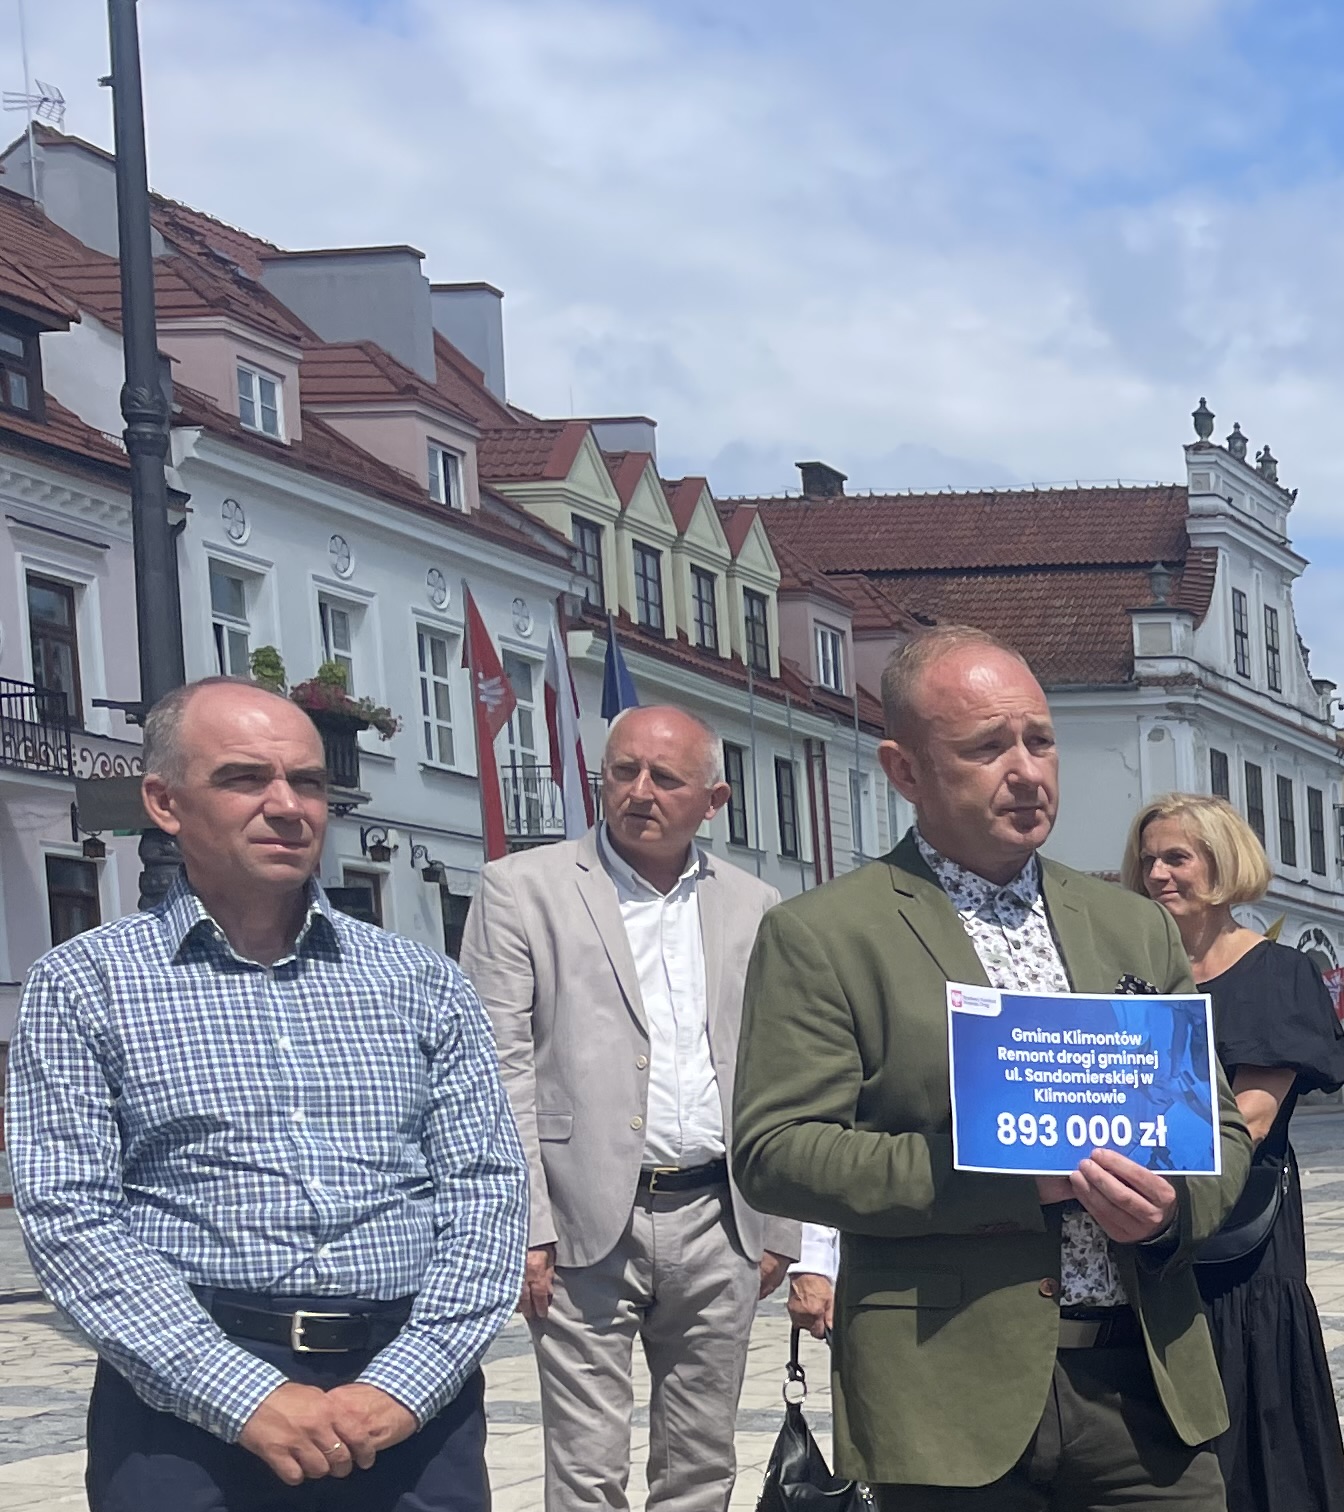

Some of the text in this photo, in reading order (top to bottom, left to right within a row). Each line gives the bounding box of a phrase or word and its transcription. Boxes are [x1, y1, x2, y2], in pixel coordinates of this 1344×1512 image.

[1012, 1028, 1141, 1046] Gmina Klimontów
[998, 1048, 1158, 1069] Remont drogi gminnej
[1005, 1068, 1153, 1086] ul. Sandomierskiej w
[1035, 1089, 1126, 1104] Klimontowie
[997, 1112, 1167, 1147] 893 000 zł
